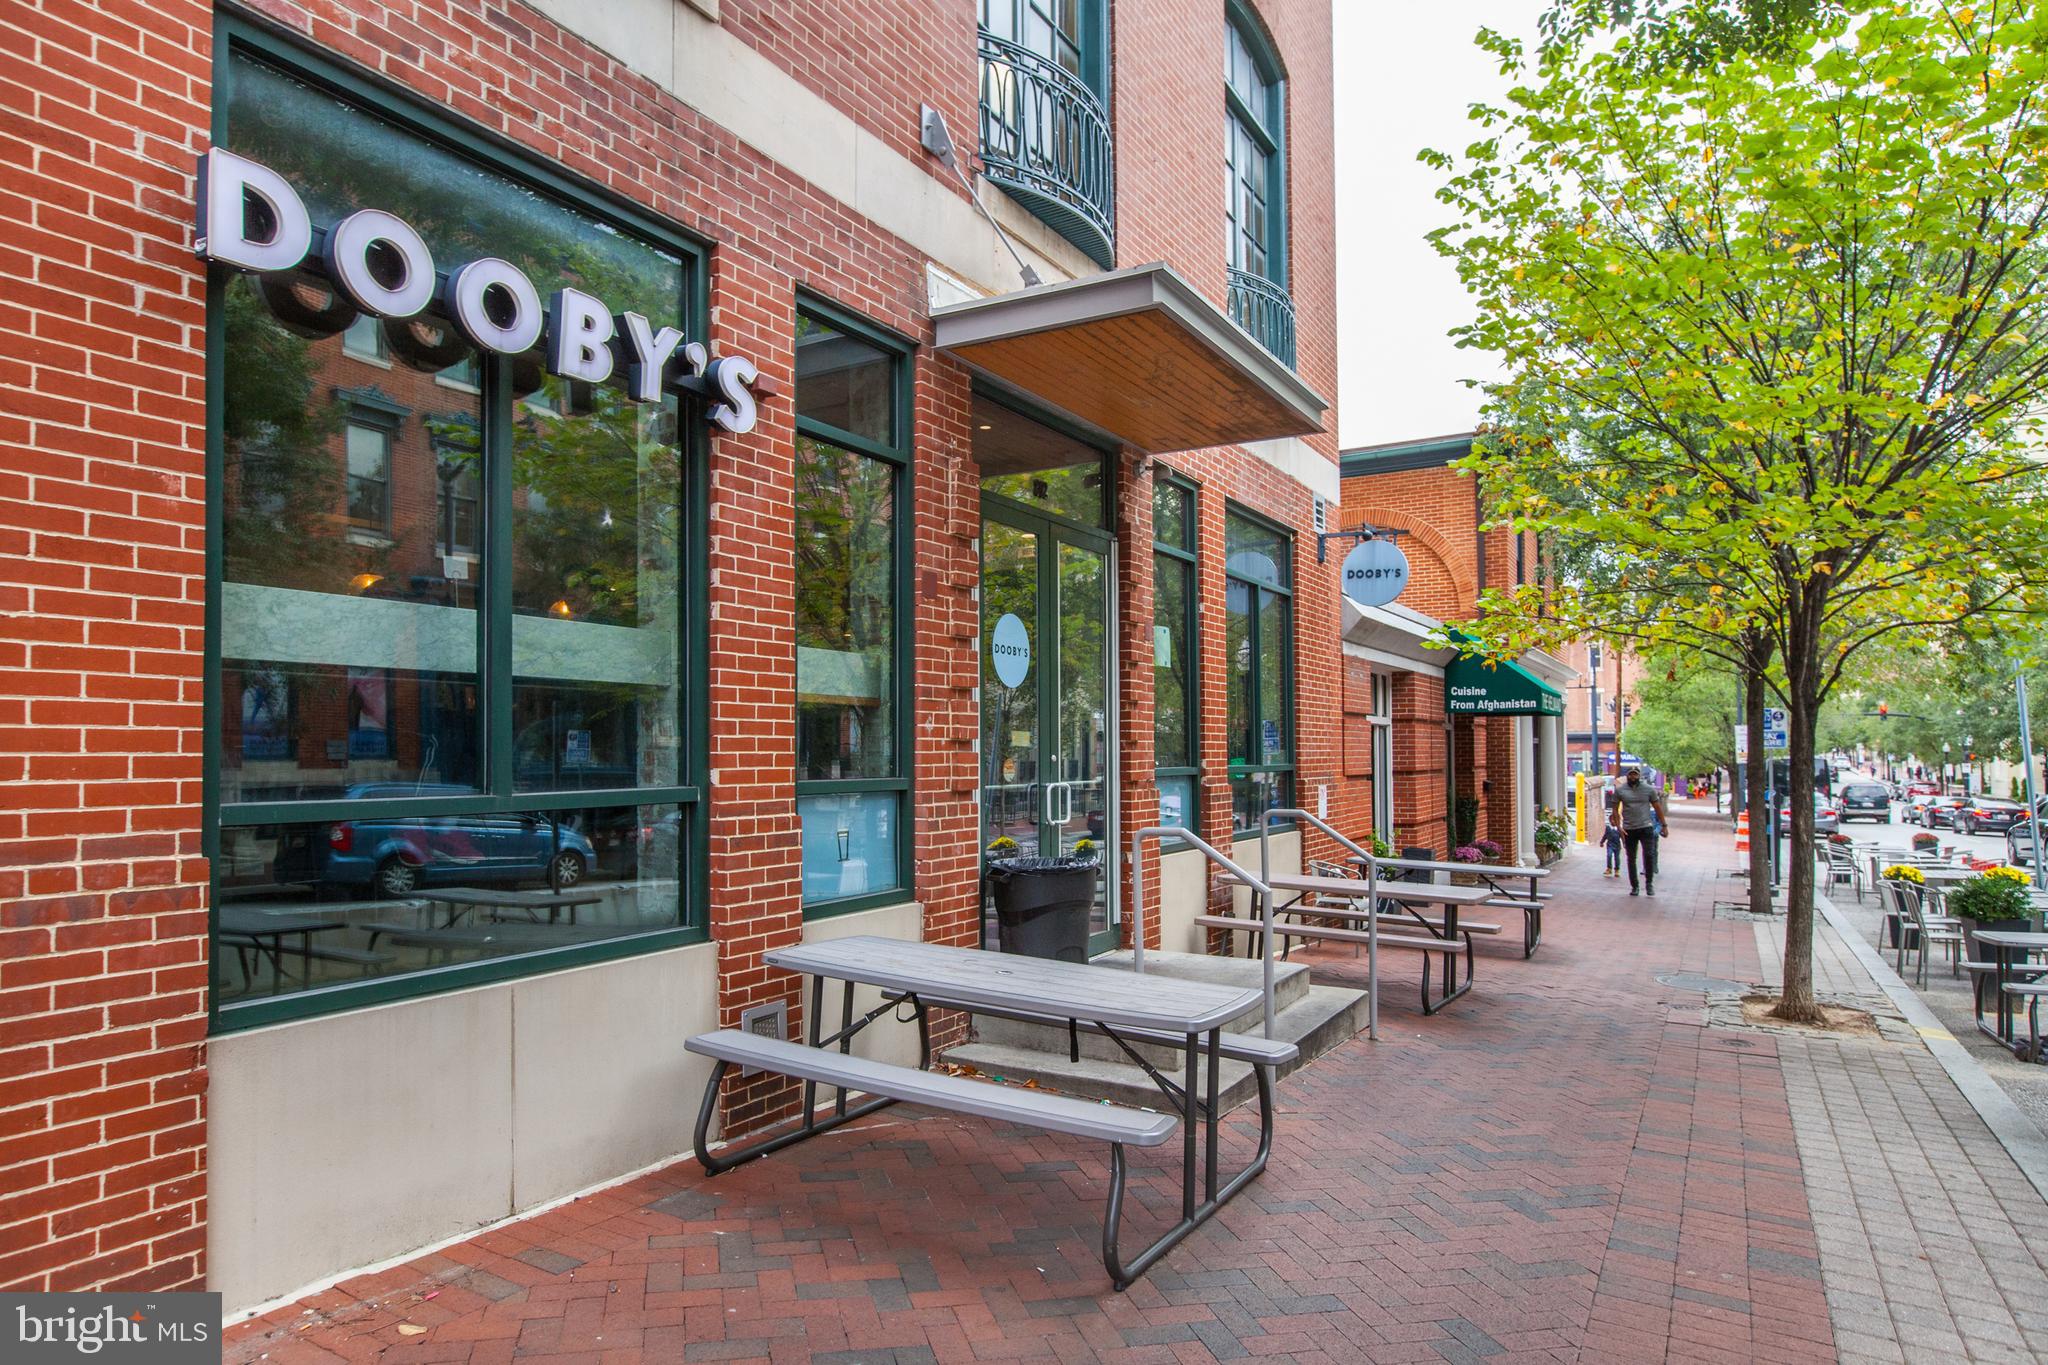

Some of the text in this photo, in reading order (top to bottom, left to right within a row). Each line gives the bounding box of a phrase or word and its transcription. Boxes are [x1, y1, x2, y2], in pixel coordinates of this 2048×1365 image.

[200, 147, 760, 434] DOOBY'S
[1347, 568, 1401, 579] DOOBY'S
[994, 643, 1029, 658] DOOBY'S
[1451, 686, 1487, 696] Cuisine
[1450, 699, 1475, 710] From
[1477, 699, 1537, 711] Afghanistan
